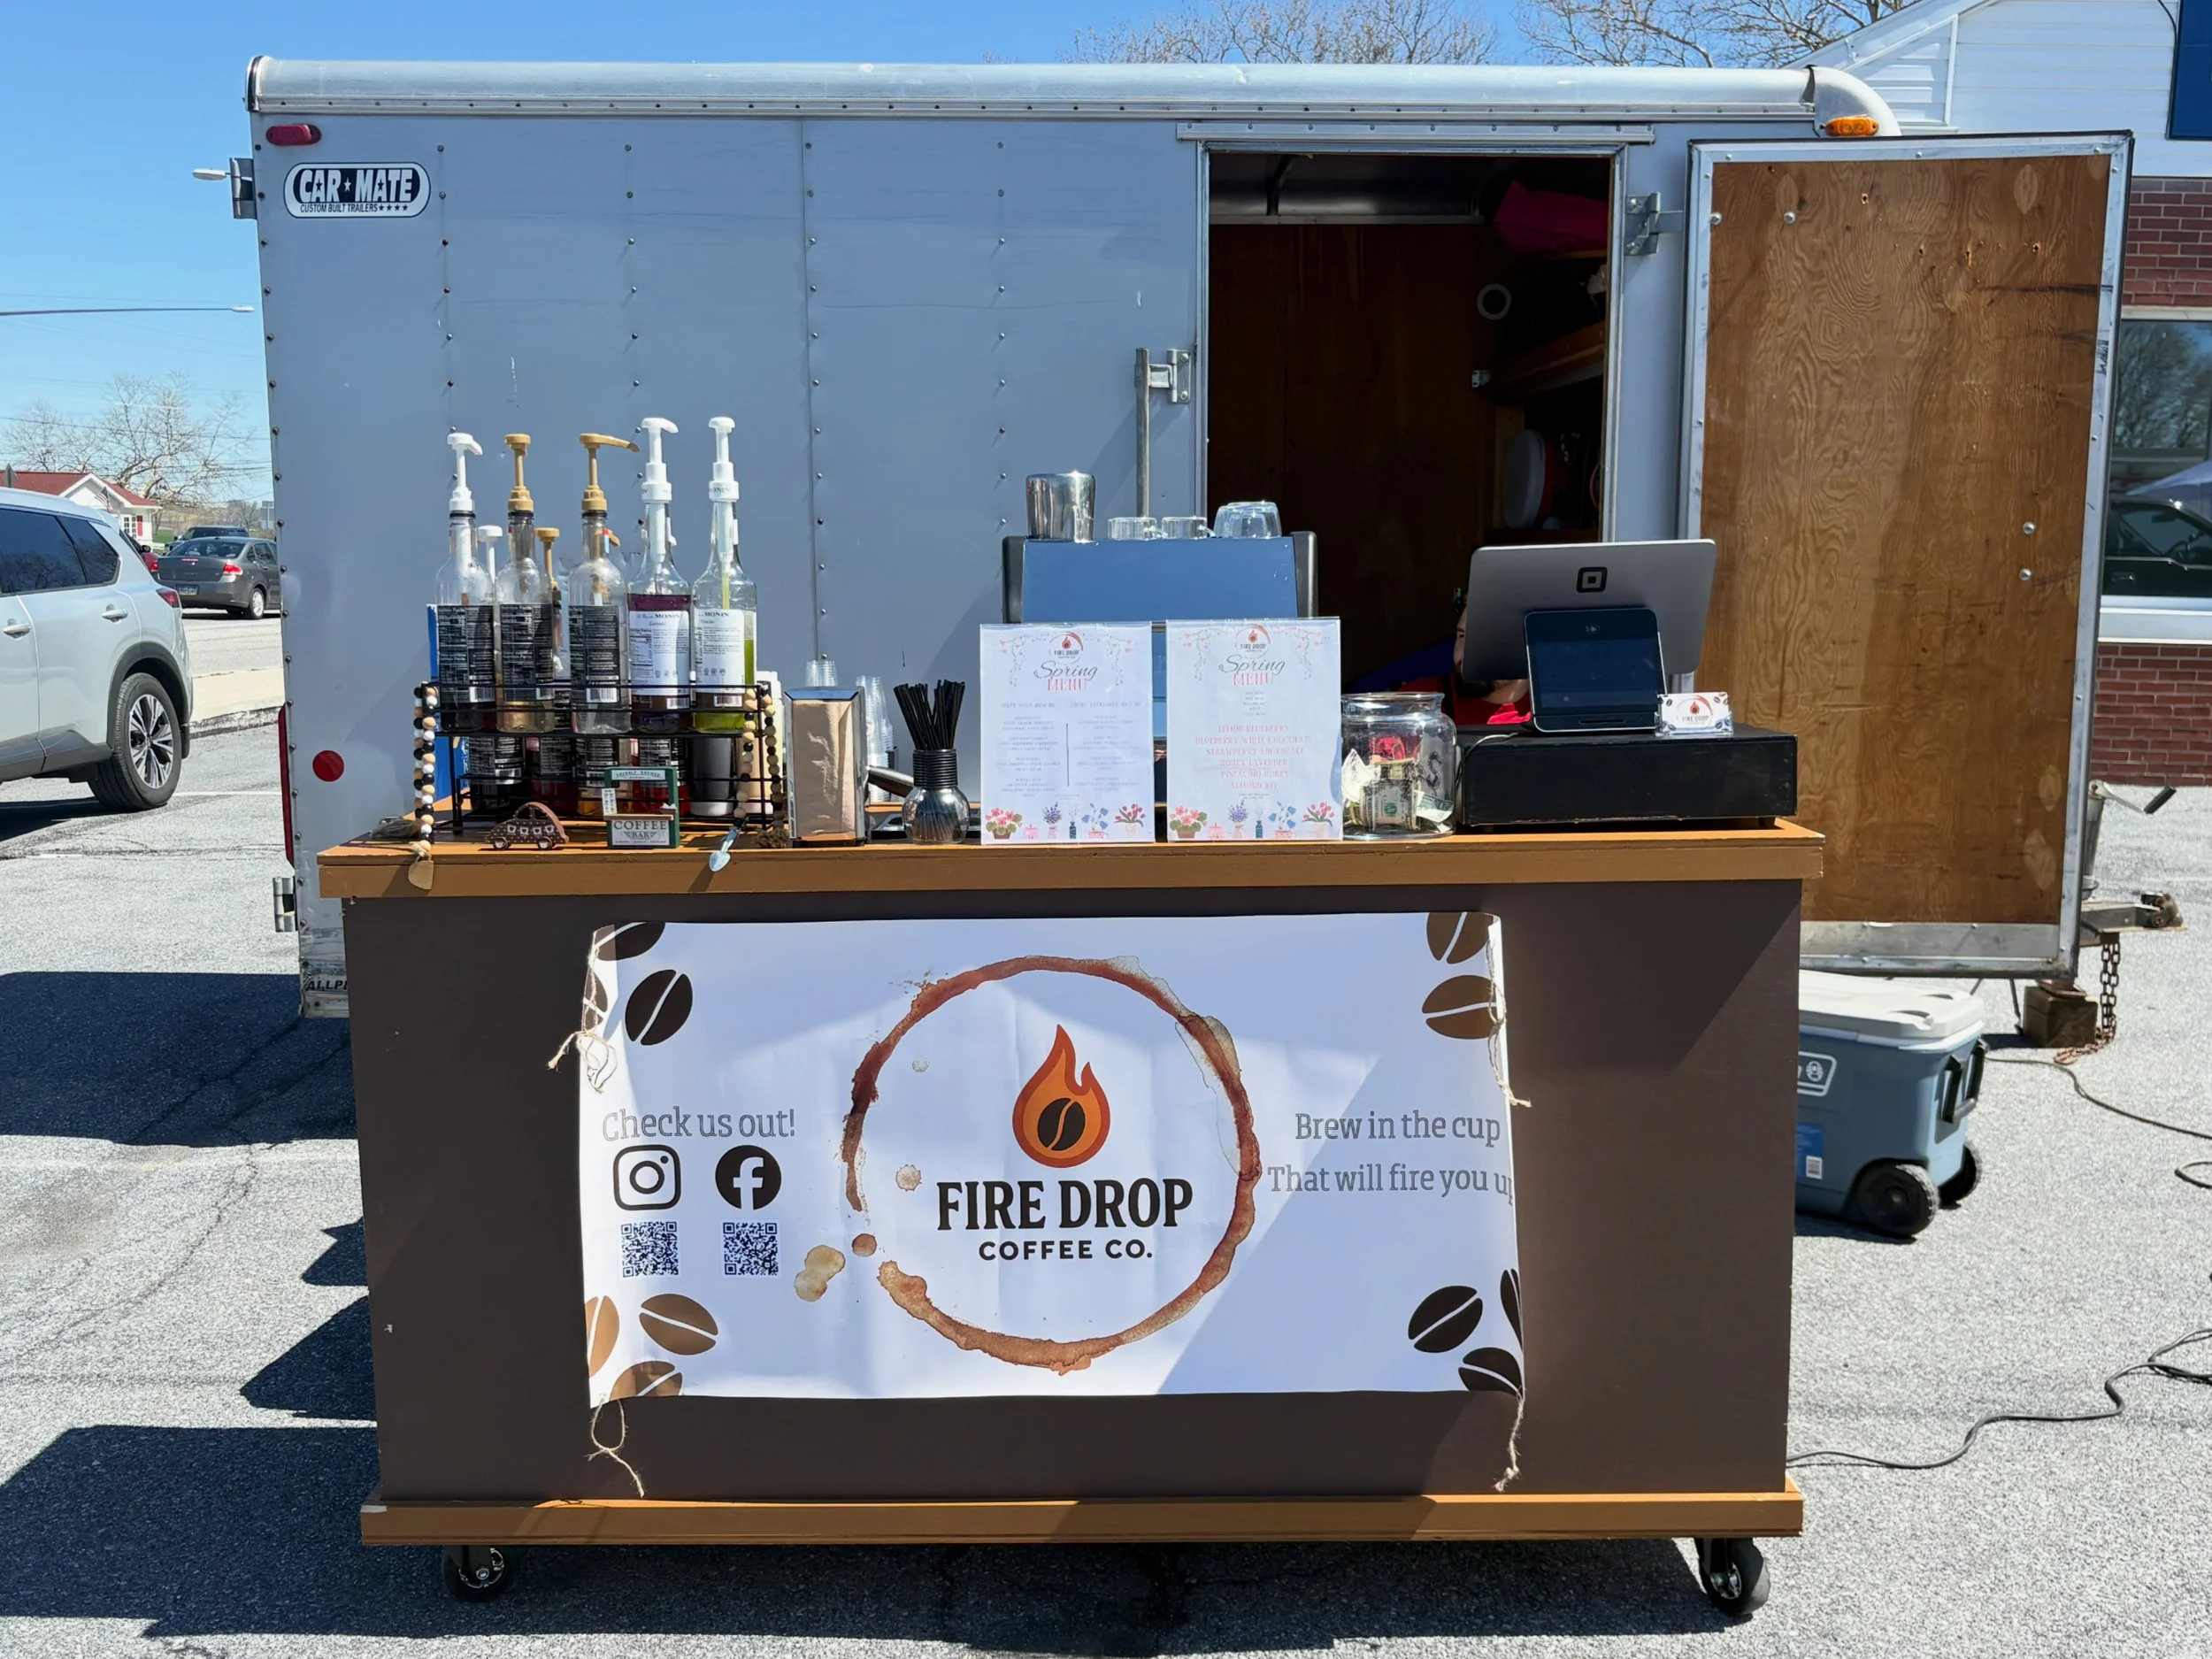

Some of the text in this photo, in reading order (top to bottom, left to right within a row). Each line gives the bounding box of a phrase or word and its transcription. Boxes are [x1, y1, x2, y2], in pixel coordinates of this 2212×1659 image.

[299, 169, 413, 204] CAR MATE
[300, 203, 378, 213] CUSTOM BUILT TRAILERS
[1033, 660, 1098, 681] Spring
[1218, 654, 1286, 676] Spring
[613, 820, 668, 830] COFFEE
[603, 1106, 795, 1141] Check us out!
[1294, 1110, 1501, 1148] Brew in the cup
[1268, 1164, 1330, 1193] That
[1334, 1163, 1384, 1192] will
[1388, 1162, 1434, 1192] fire
[1439, 1169, 1489, 1198] you
[936, 1178, 1194, 1231] FIRE DROP
[979, 1239, 1153, 1261] COFFEE CO.
